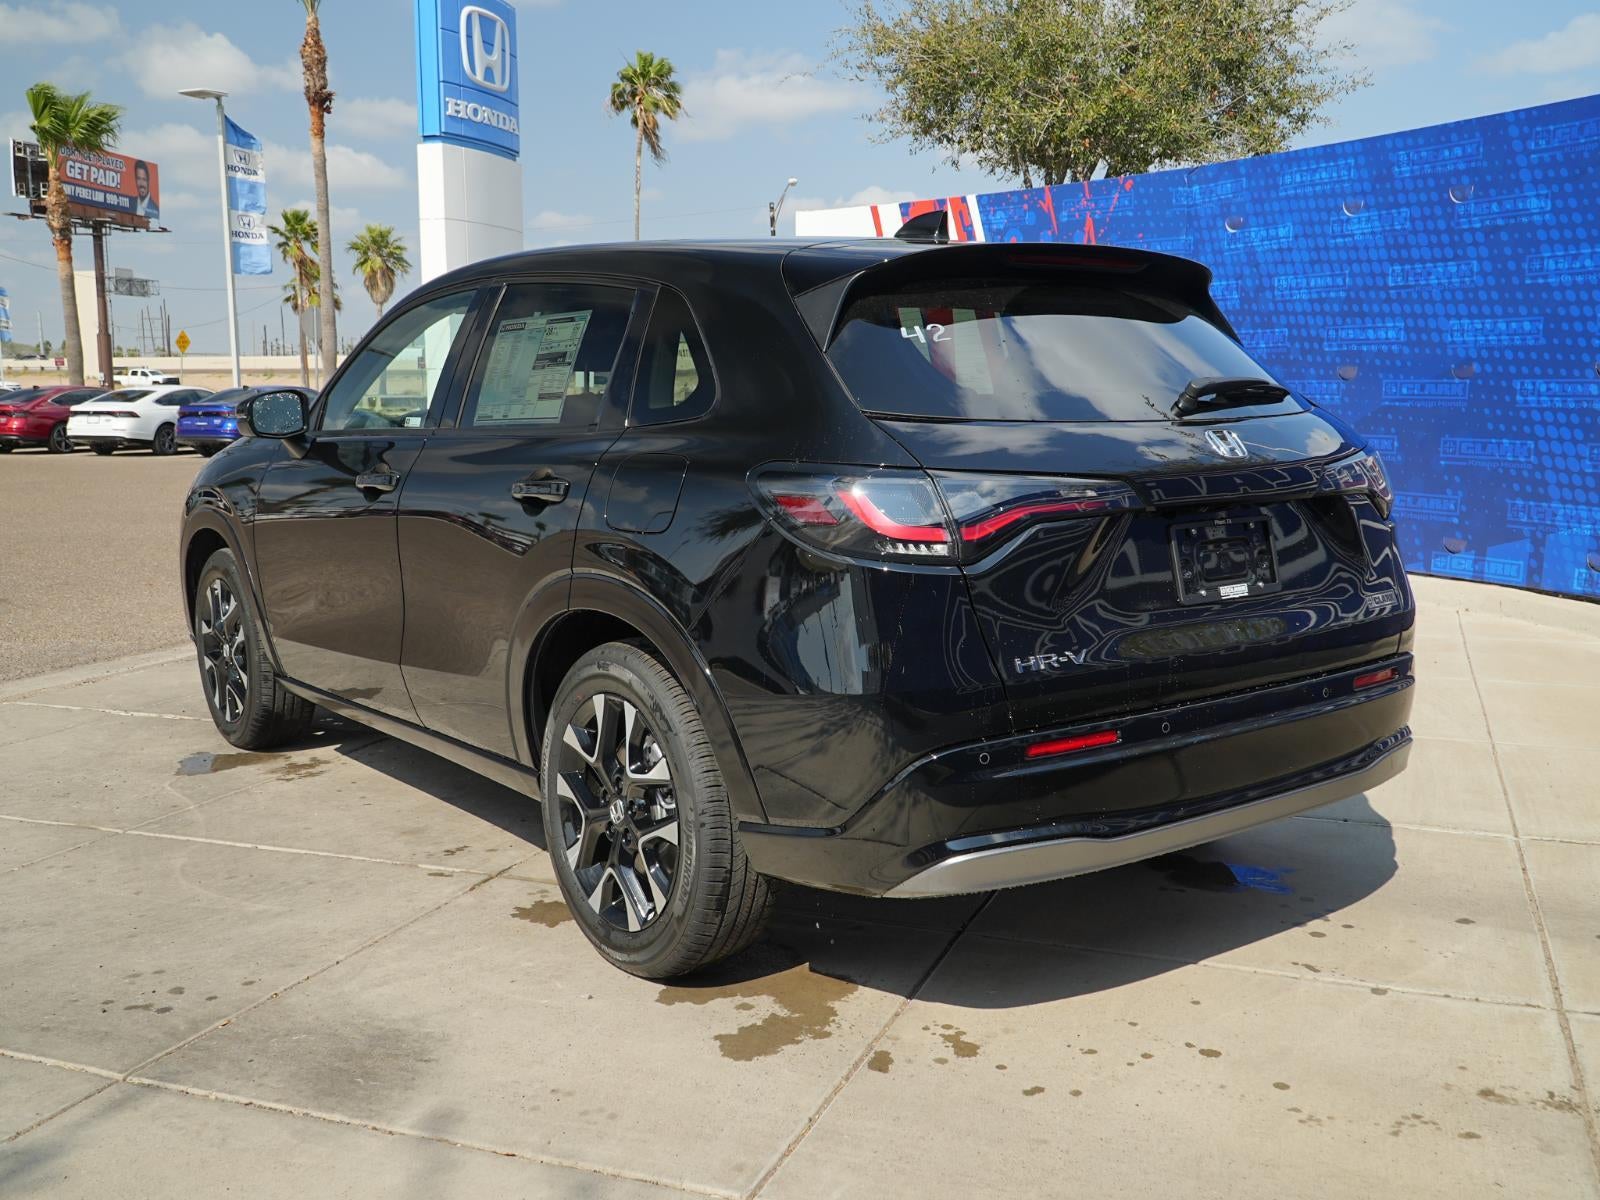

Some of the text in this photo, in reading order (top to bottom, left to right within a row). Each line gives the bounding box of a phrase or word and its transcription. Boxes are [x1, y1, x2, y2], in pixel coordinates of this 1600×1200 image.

[445, 97, 520, 135] HONDA
[66, 160, 121, 188] GET PAID!
[227, 164, 258, 176] HONDA
[75, 185, 92, 200] PEREZ
[231, 230, 264, 240] HONDA
[504, 322, 526, 331] HONDA
[900, 324, 952, 343] 42
[1014, 649, 1087, 674] HR-V
